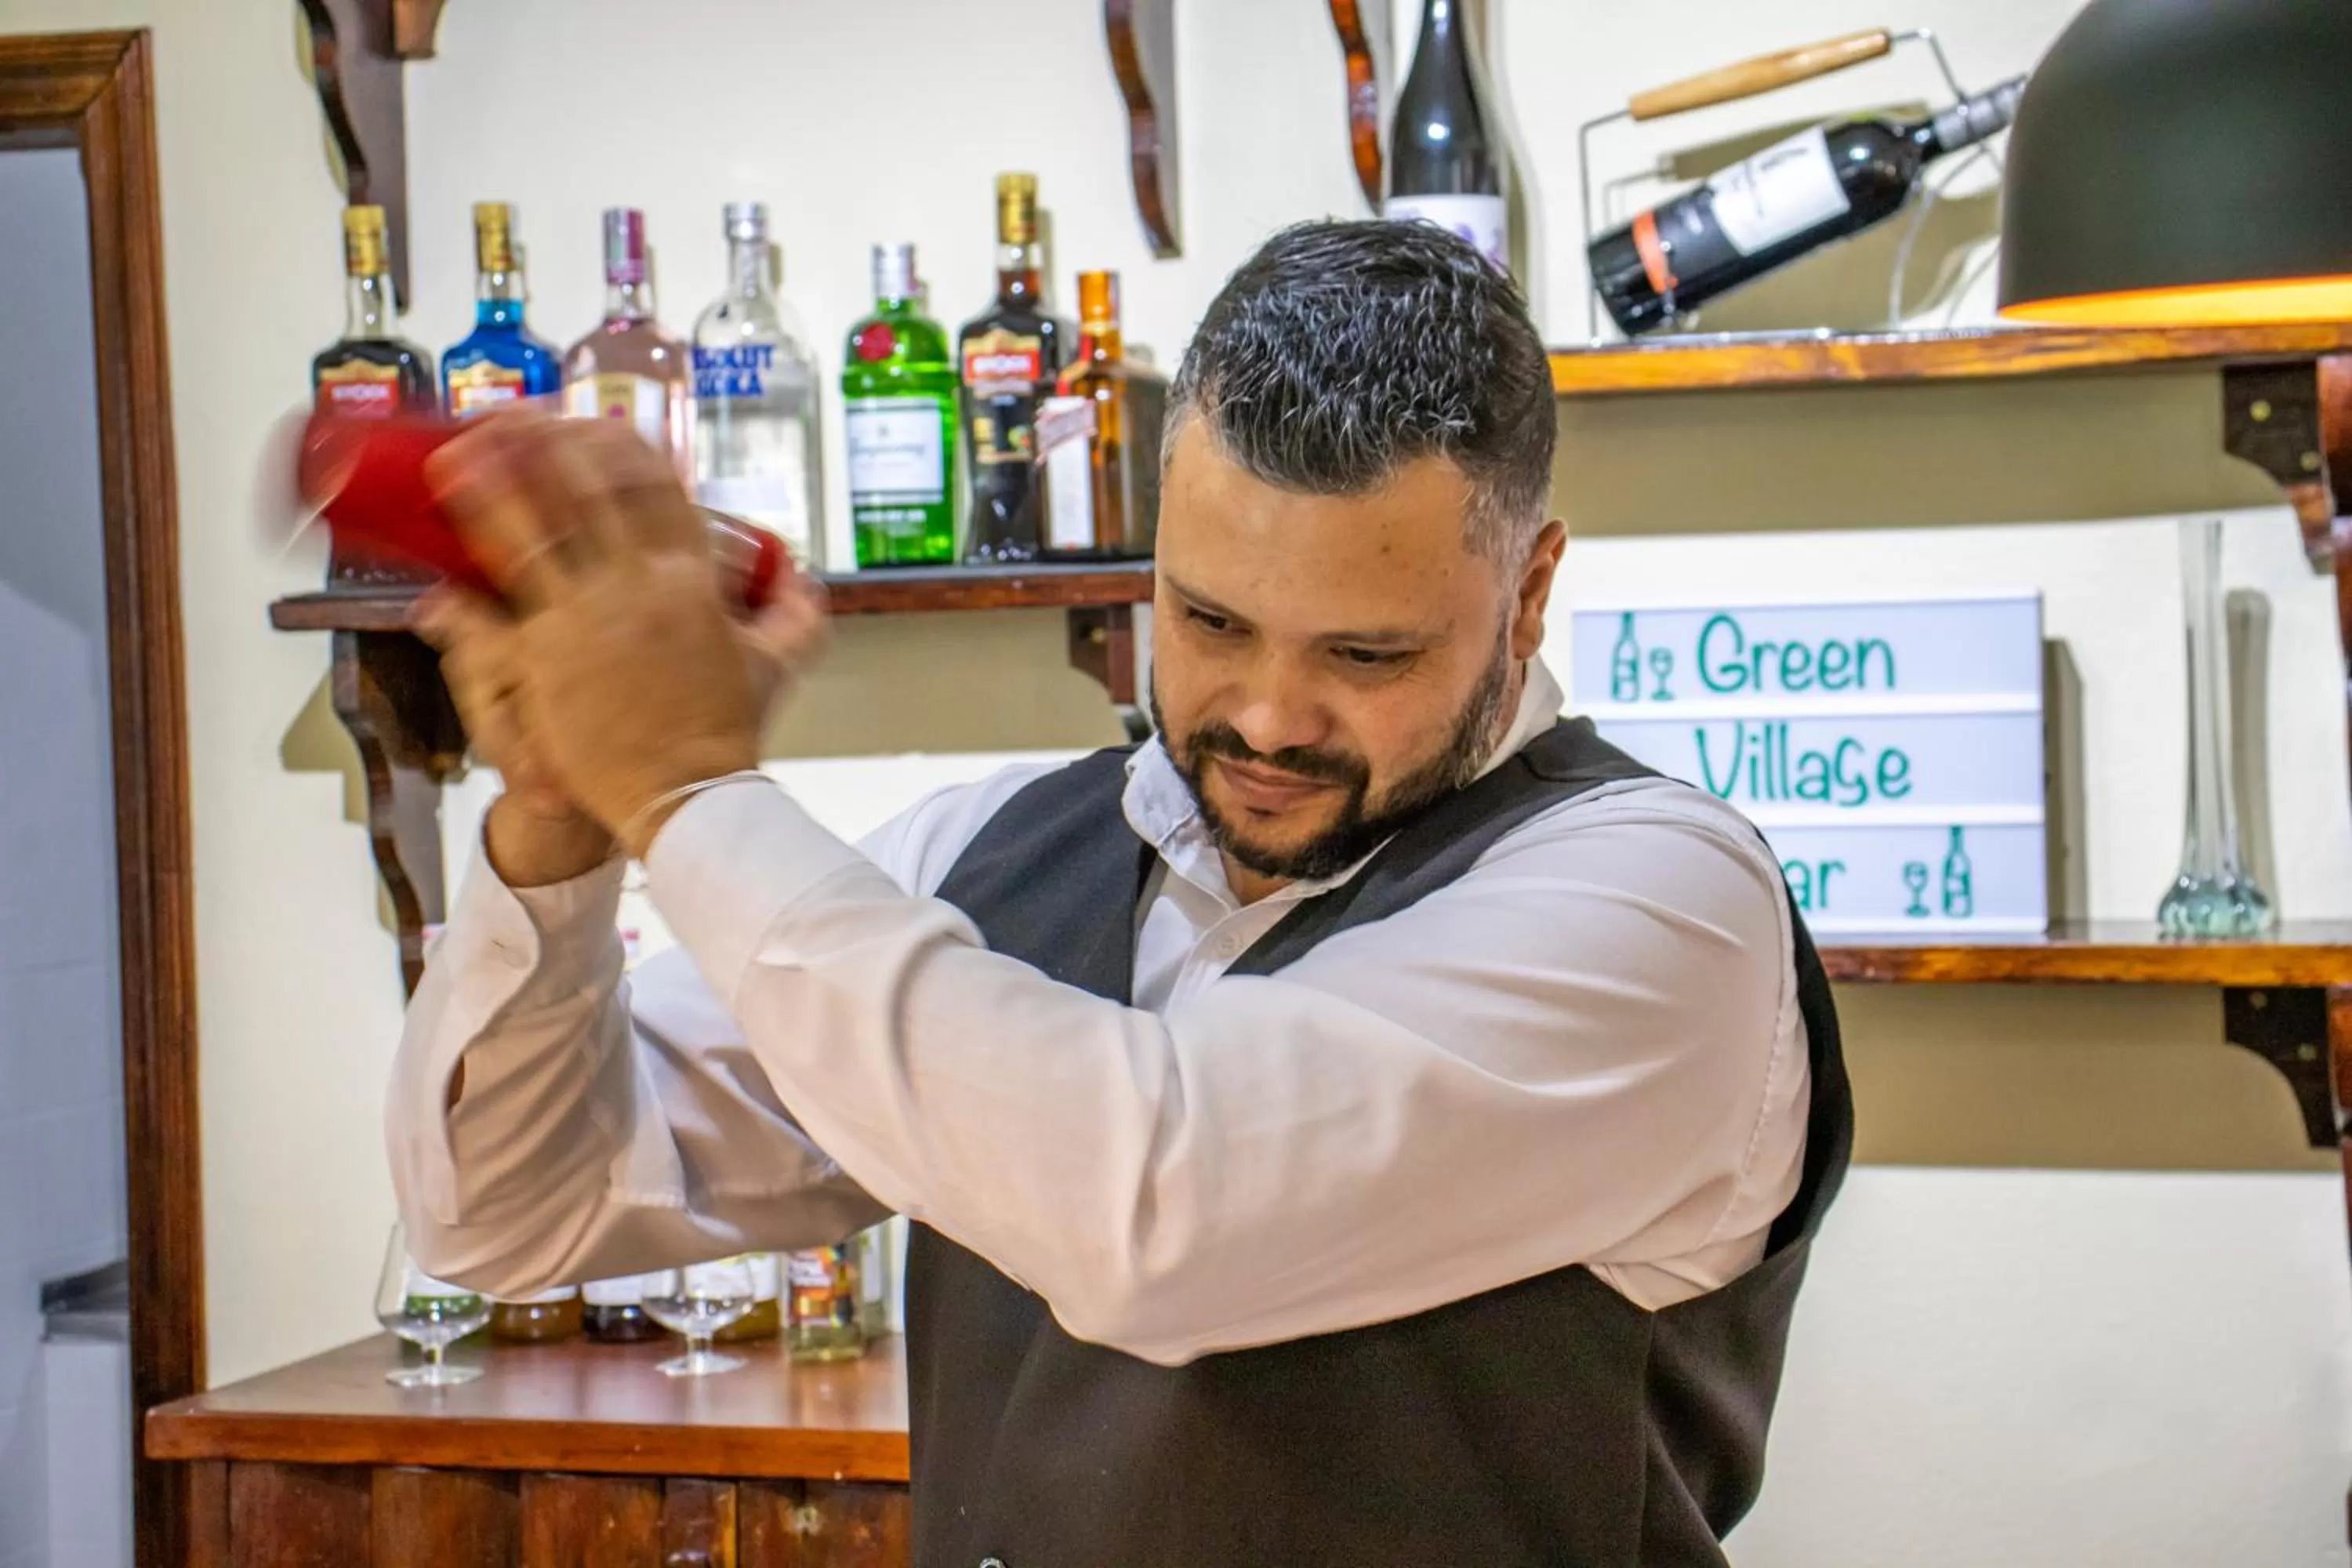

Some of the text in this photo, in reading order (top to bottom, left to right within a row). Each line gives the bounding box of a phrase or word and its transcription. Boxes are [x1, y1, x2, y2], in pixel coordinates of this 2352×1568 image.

[1696, 612, 1896, 694] Green
[1693, 720, 1911, 807] Village
[1780, 858, 1846, 912] ar
